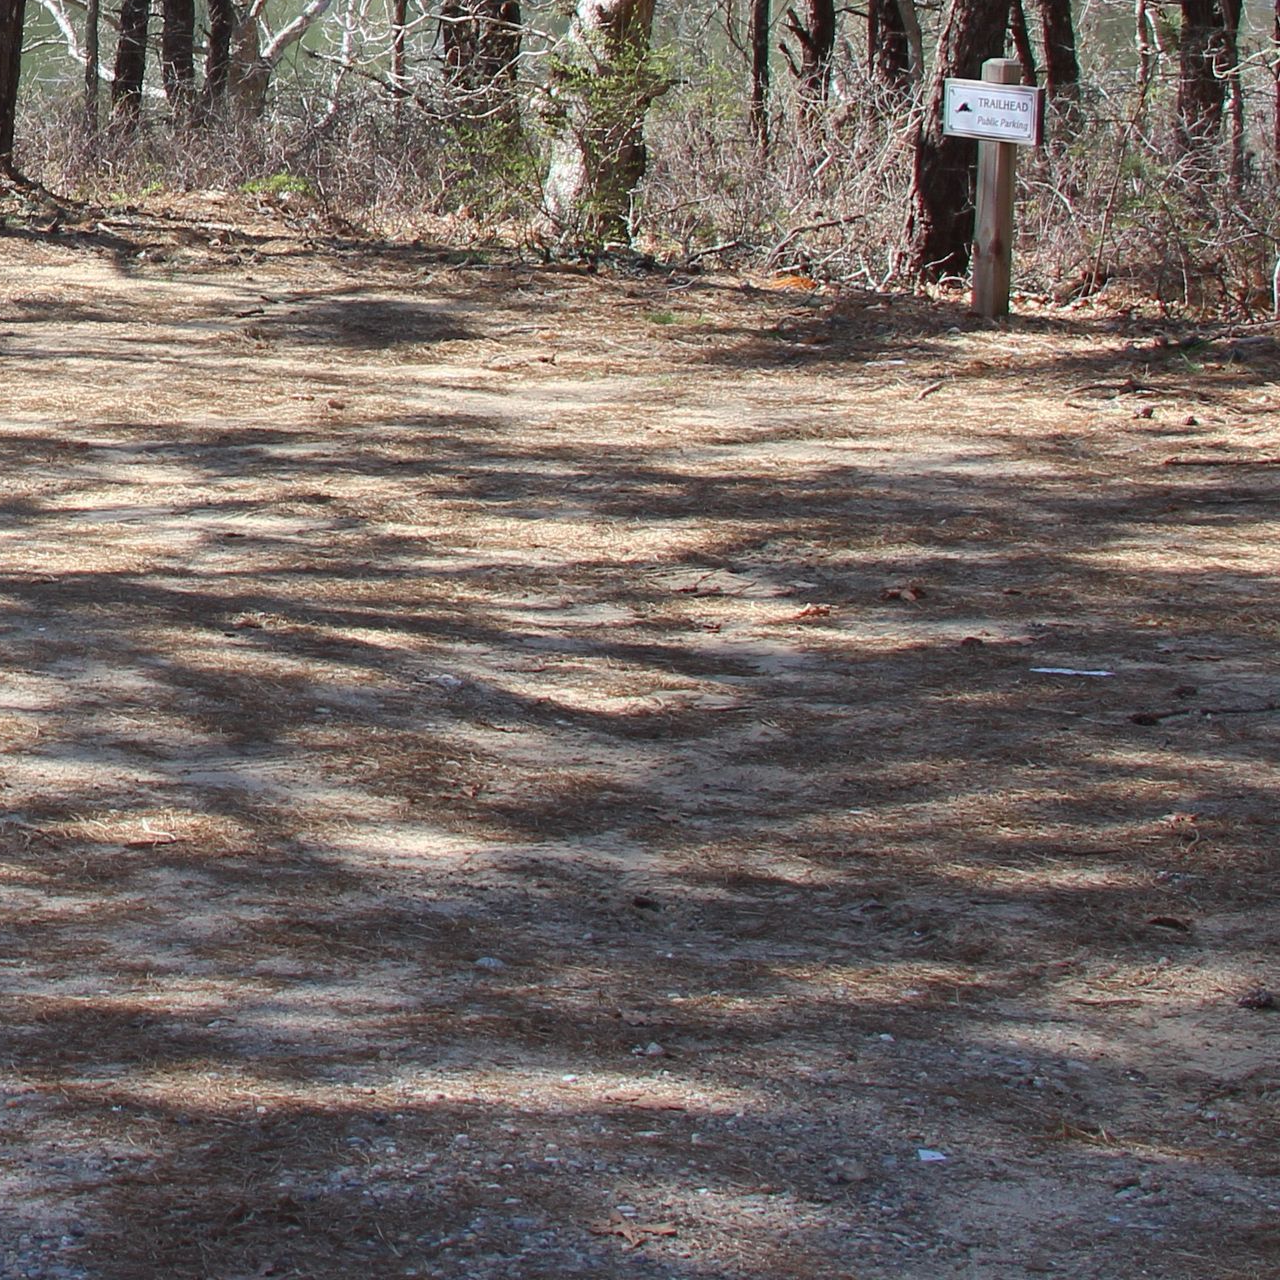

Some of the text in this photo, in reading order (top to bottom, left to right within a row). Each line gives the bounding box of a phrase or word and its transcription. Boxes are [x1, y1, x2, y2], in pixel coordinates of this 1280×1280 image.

[978, 97, 1029, 113] TRAILHEAD
[977, 115, 1029, 132] Public Parking
